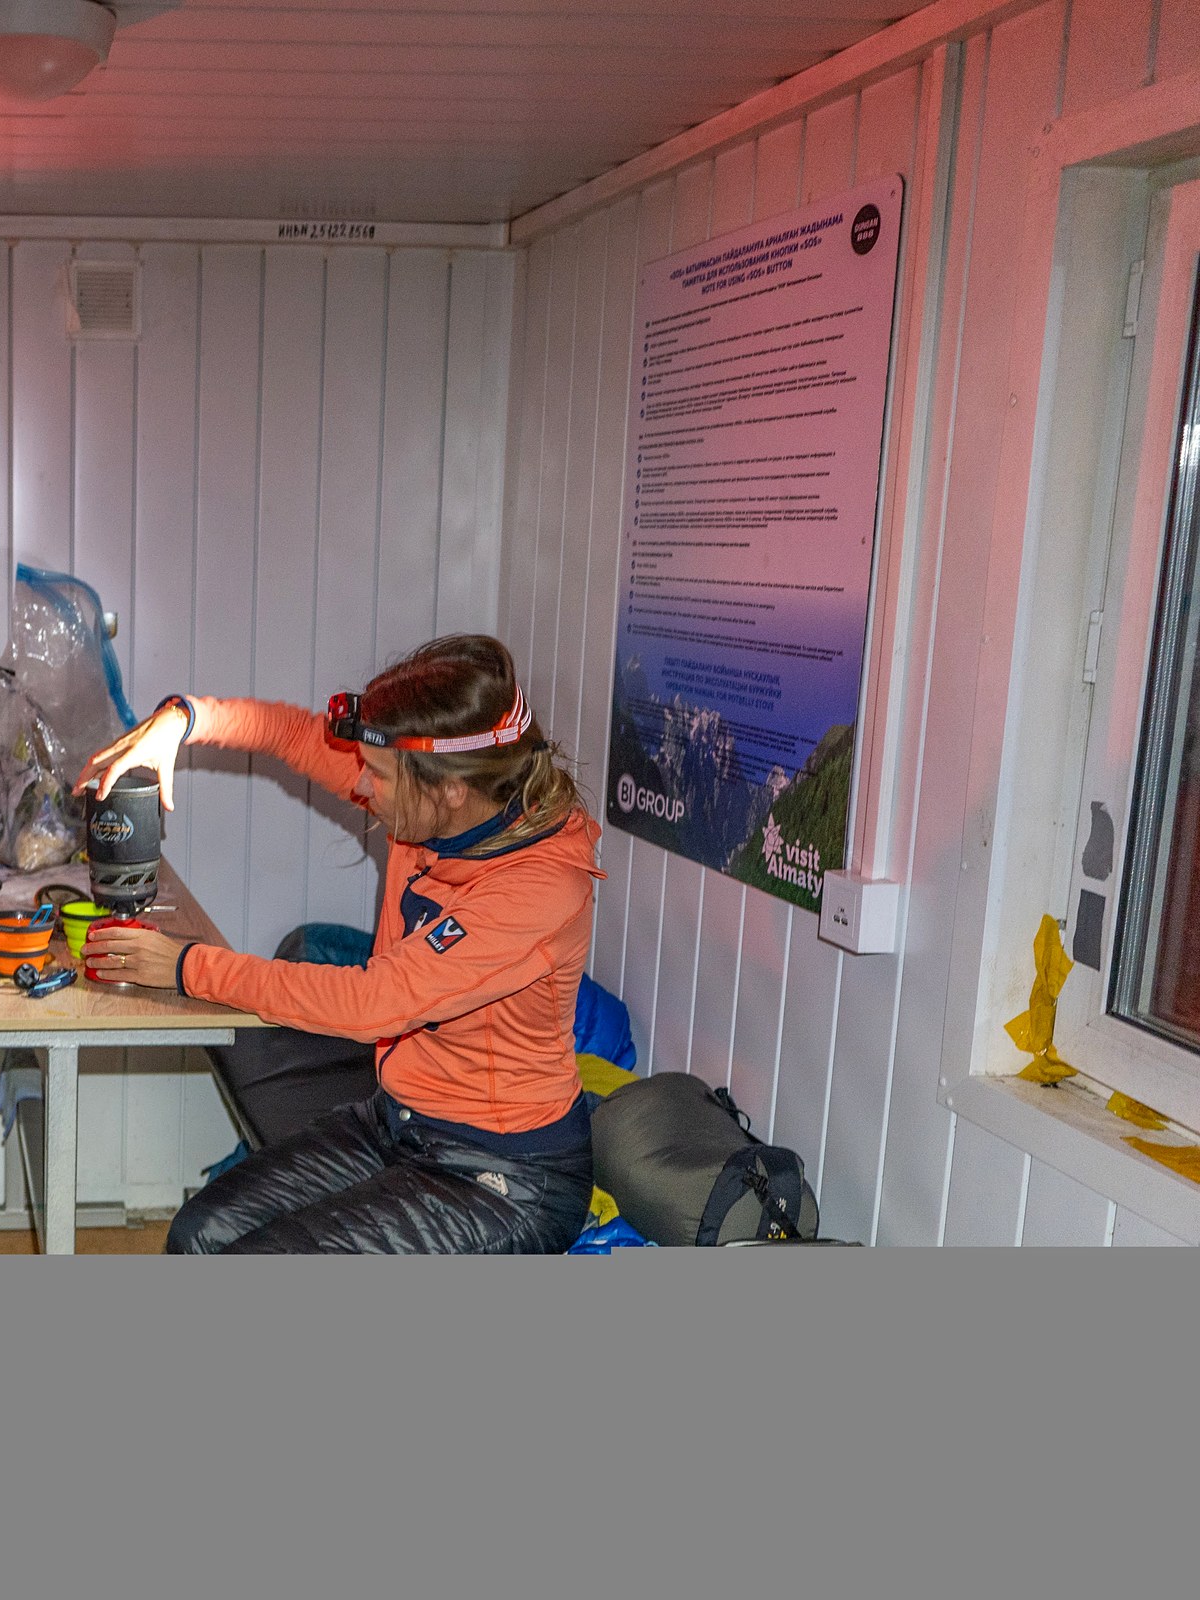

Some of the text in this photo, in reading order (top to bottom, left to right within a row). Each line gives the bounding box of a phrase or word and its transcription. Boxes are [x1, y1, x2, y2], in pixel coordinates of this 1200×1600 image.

[766, 259, 793, 275] BUTTON
[622, 781, 685, 823] BI GROUP
[786, 838, 820, 872] visit
[767, 853, 823, 898] Almaty
